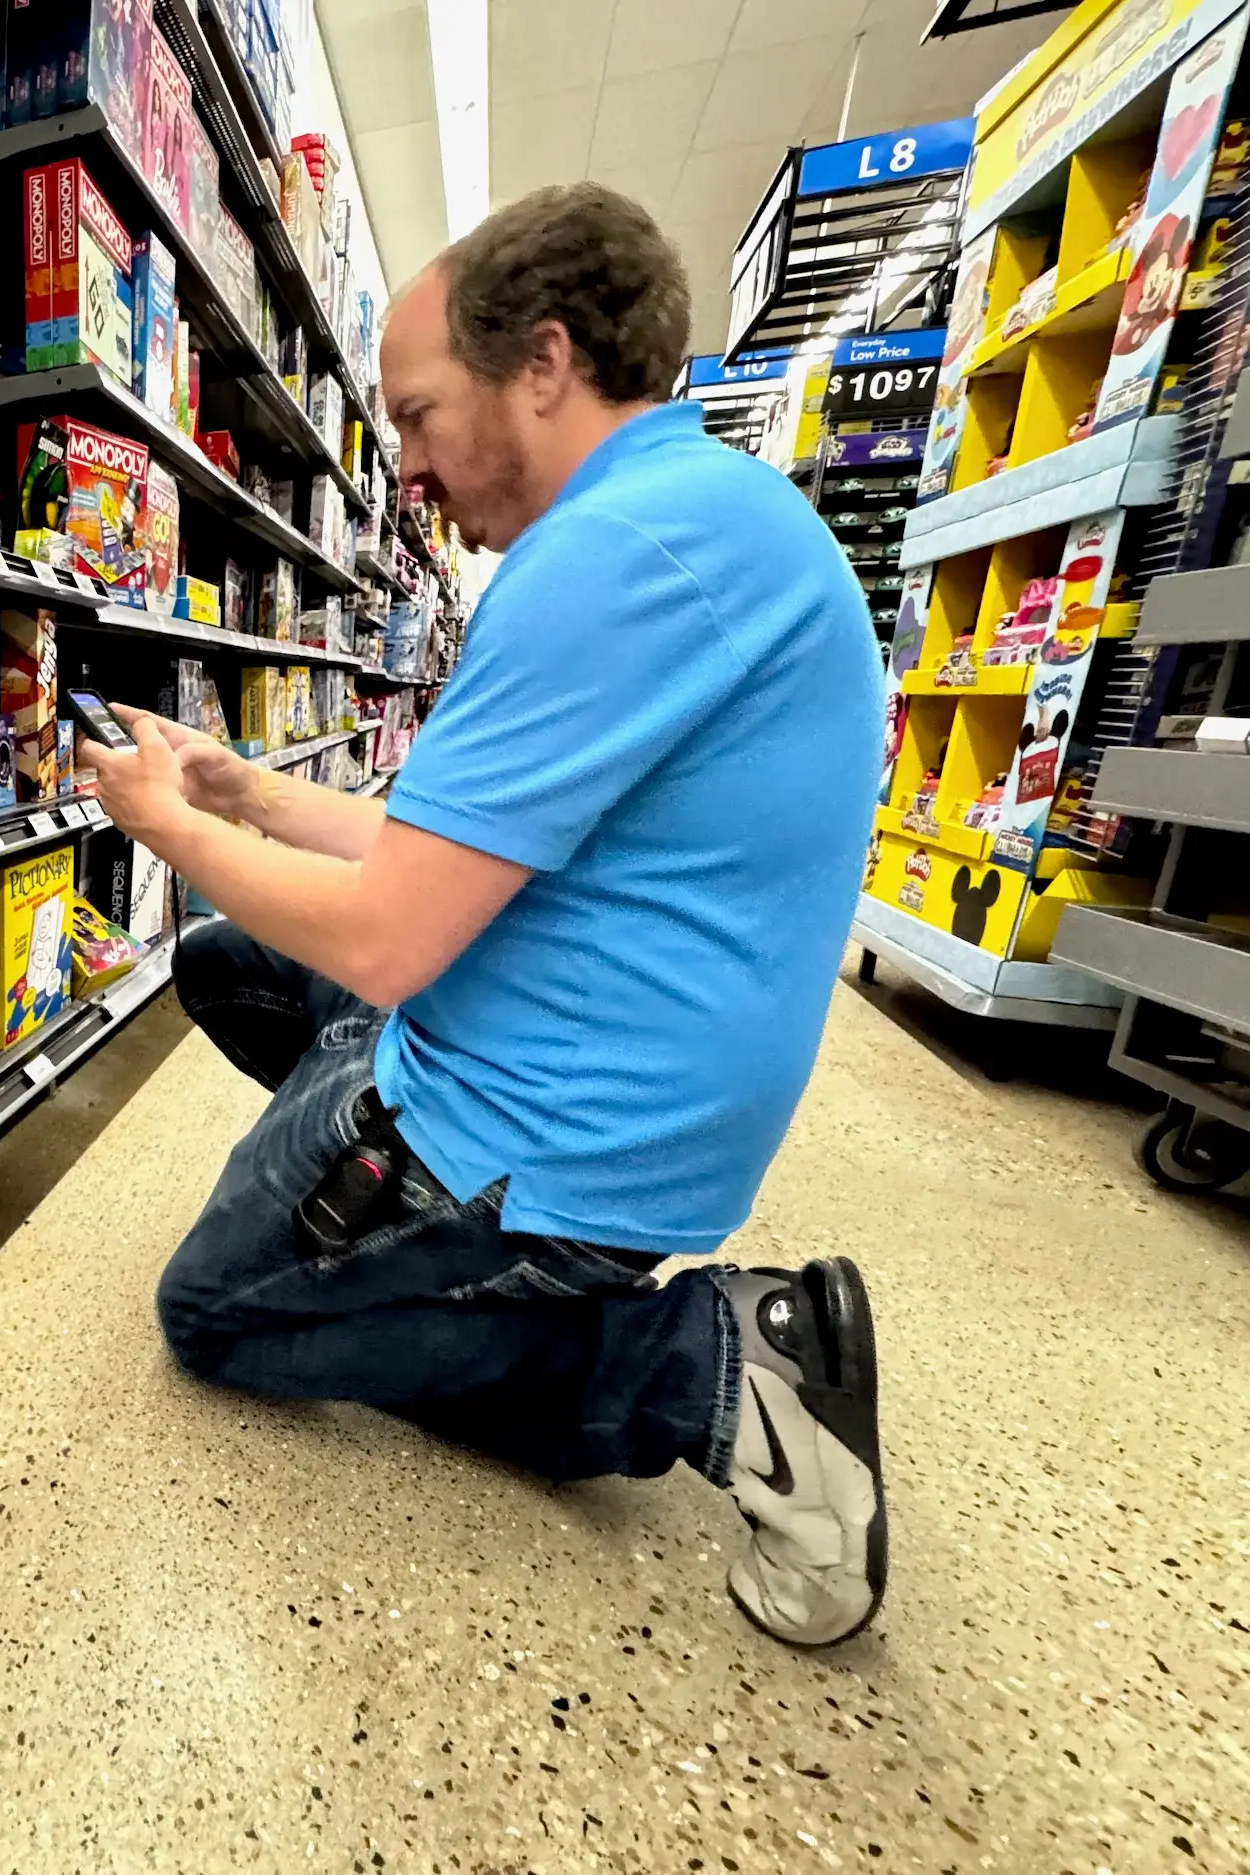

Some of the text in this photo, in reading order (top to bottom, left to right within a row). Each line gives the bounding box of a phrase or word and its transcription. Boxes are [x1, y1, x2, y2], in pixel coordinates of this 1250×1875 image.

[858, 138, 917, 179] L 8
[31, 178, 45, 263] MONOPOLY
[60, 169, 74, 257] MONOPOLY
[82, 182, 129, 261] MONOPOLY
[850, 346, 910, 361] Low Price
[852, 339, 886, 348] Everyday
[71, 431, 145, 478] MONOPOLY
[153, 513, 171, 544] GO!
[37, 618, 57, 699] Jenga
[9, 852, 71, 900] PICTIONARY
